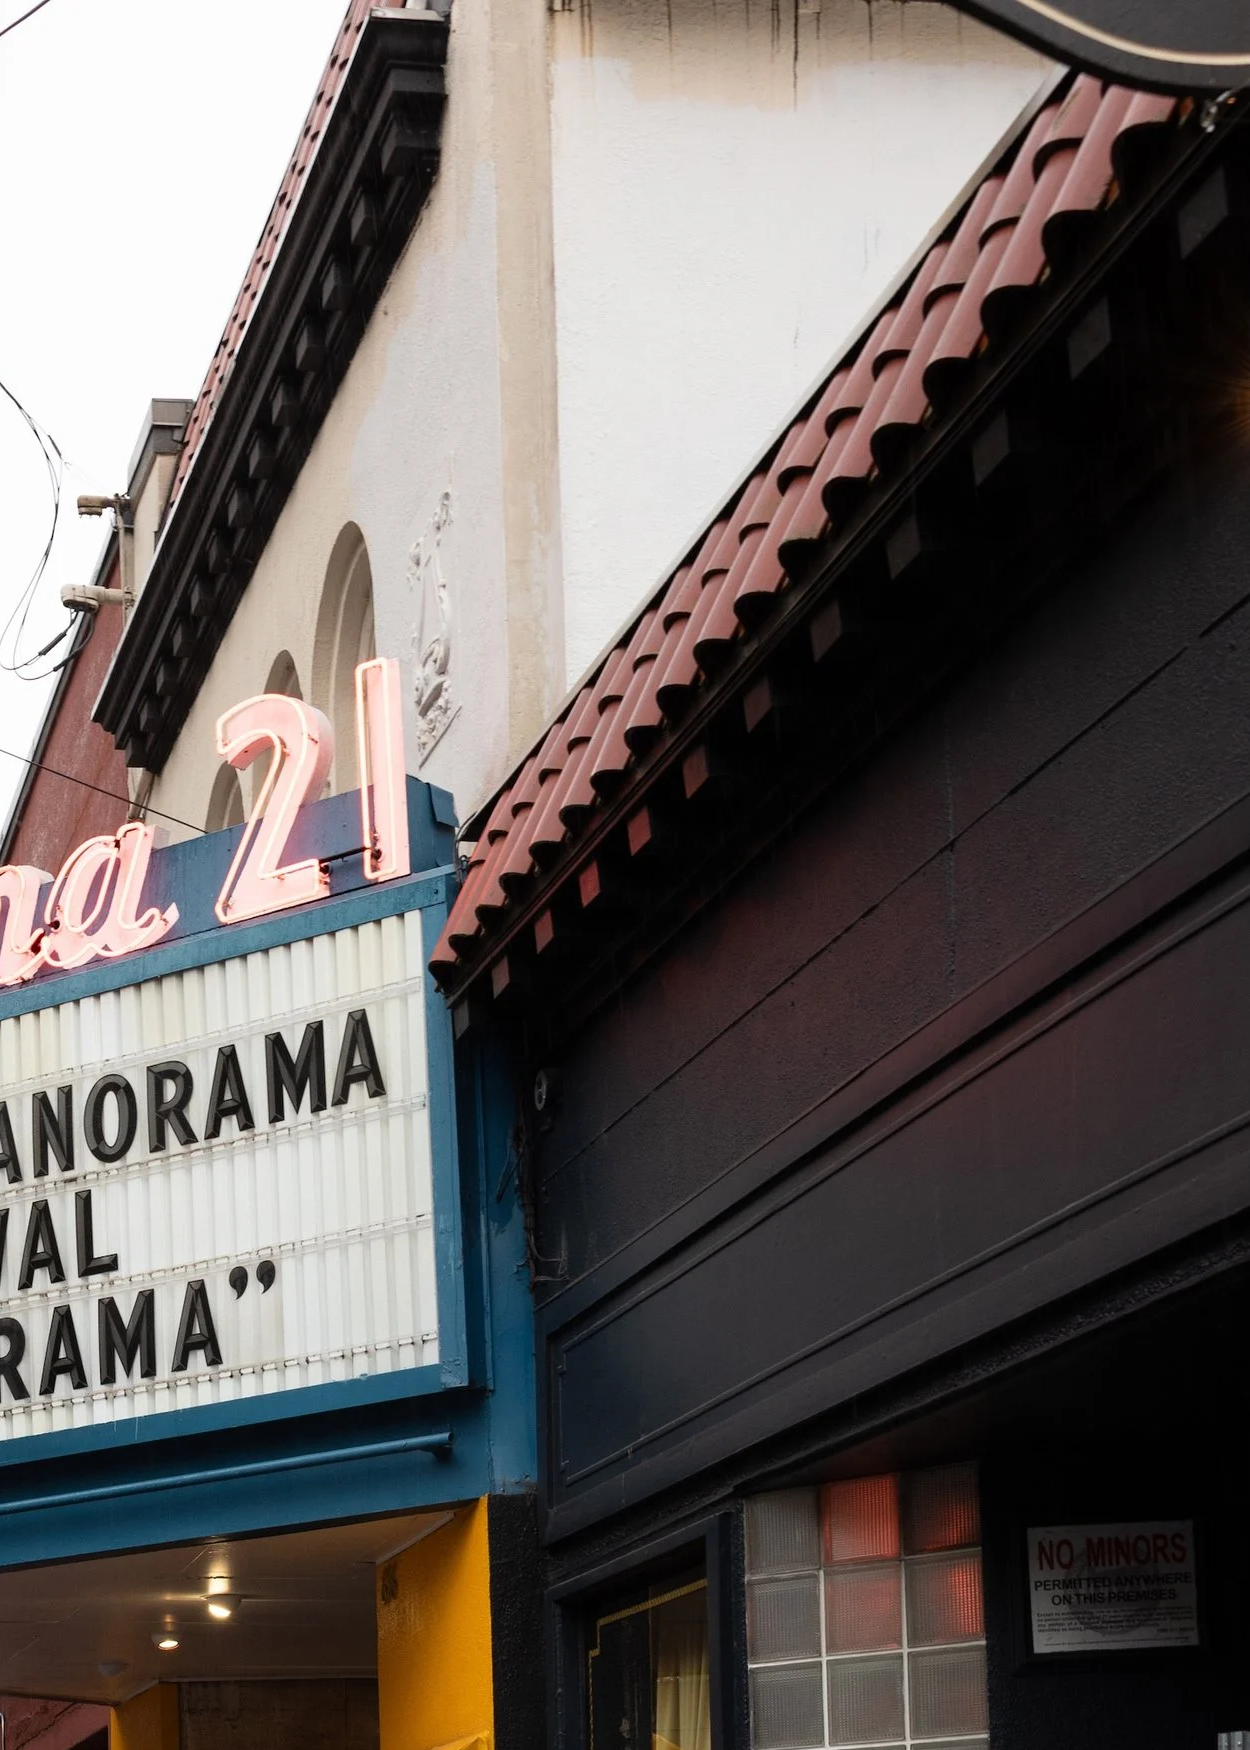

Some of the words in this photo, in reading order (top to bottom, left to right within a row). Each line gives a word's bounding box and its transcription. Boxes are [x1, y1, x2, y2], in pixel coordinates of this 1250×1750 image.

[214, 656, 411, 924] 21
[1037, 1538, 1074, 1571] NO
[1086, 1532, 1187, 1568] MINORS
[1034, 1576, 1111, 1591] PERMITTED
[1114, 1571, 1193, 1587] ANYWHERE
[1051, 1594, 1072, 1606] ON
[1075, 1592, 1106, 1605] THIS
[1108, 1588, 1177, 1603] PREMISES
